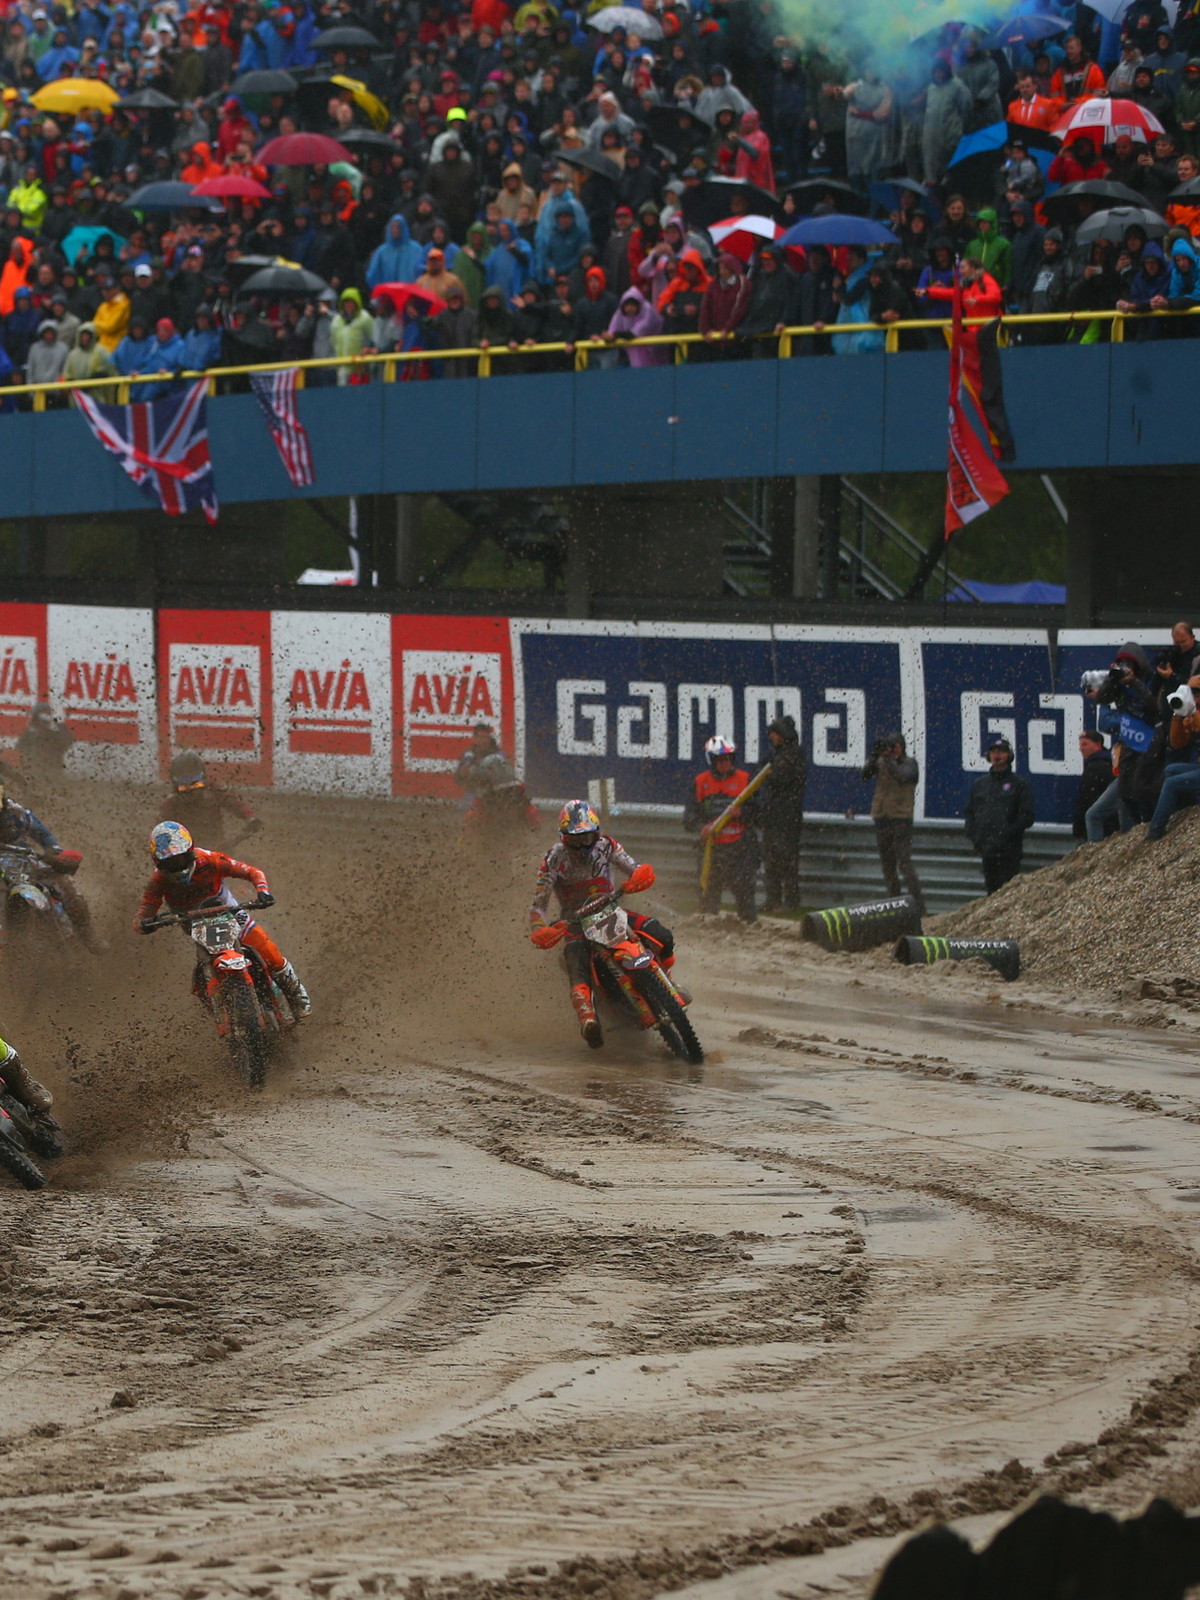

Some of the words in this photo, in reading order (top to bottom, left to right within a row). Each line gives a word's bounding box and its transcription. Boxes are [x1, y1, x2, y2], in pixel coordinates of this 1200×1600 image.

[960, 690, 1112, 776] Ga
[1121, 725, 1145, 743] OTO
[849, 899, 910, 916] MONSTER
[950, 940, 1009, 950] MONSTER
